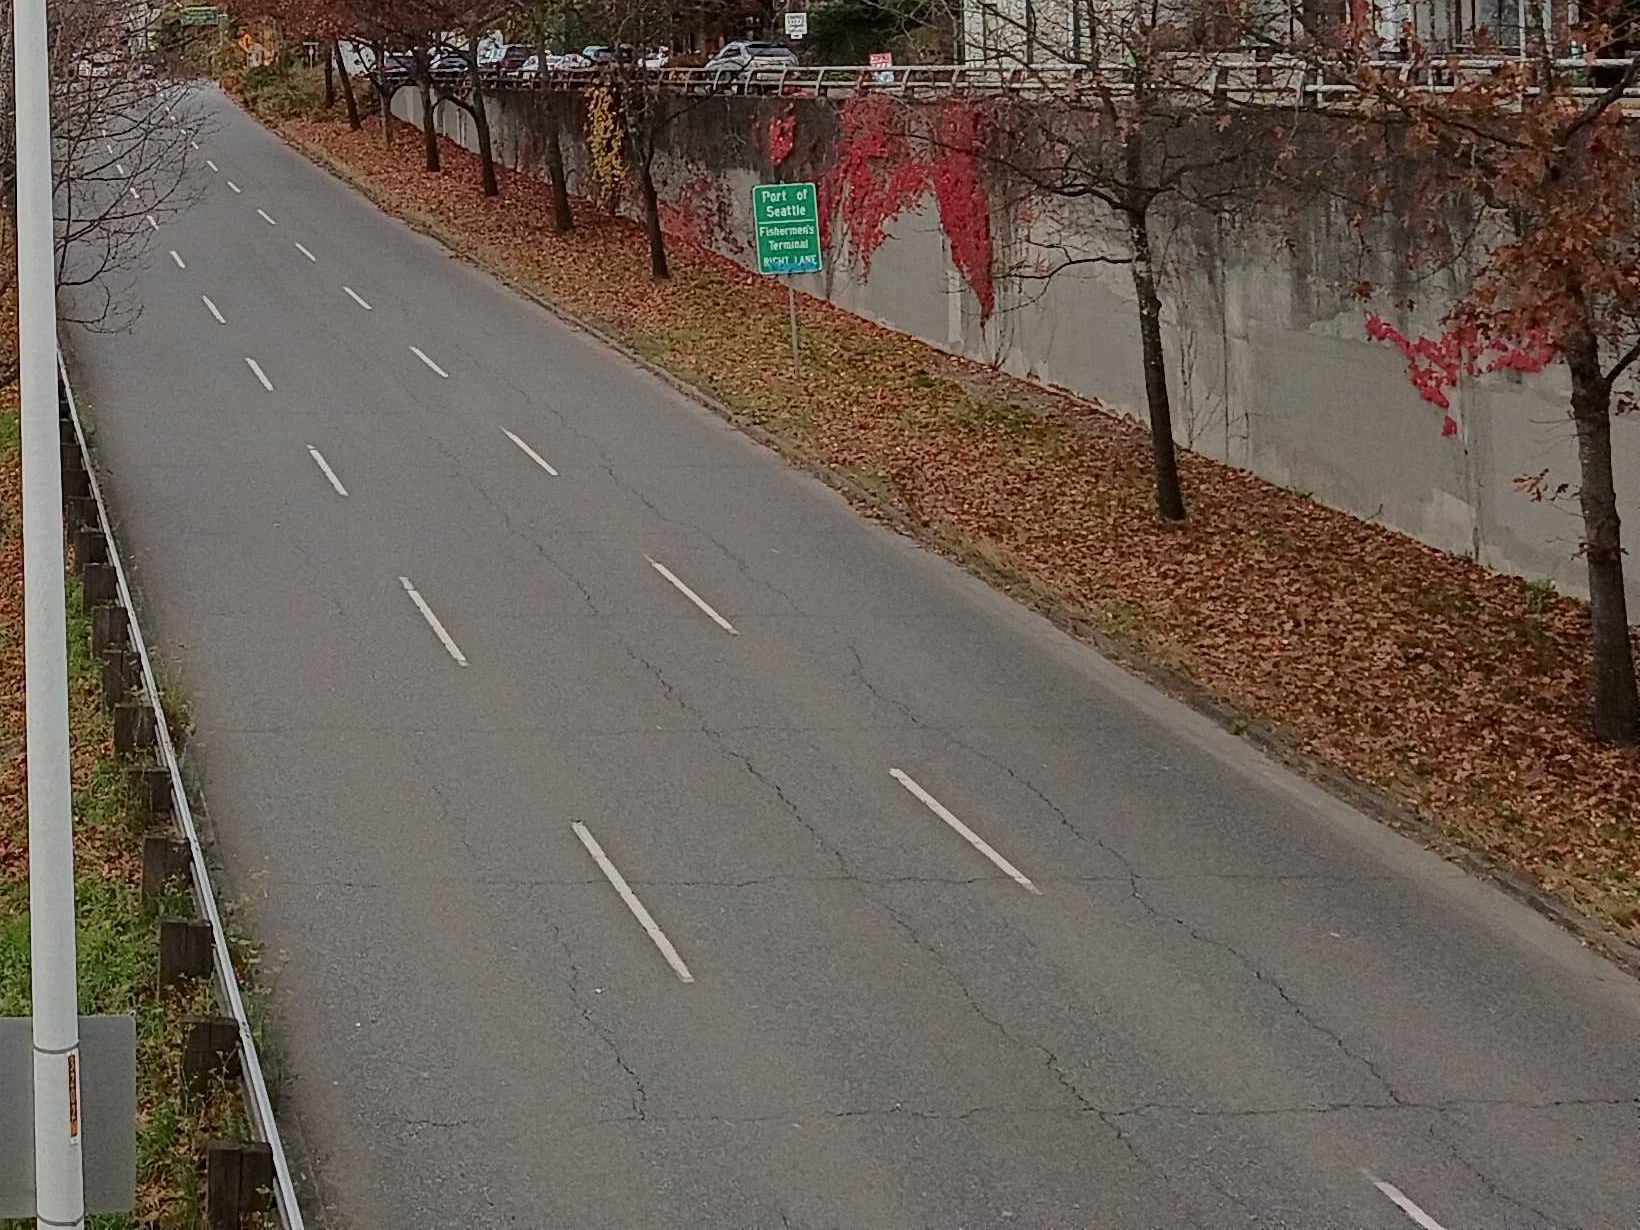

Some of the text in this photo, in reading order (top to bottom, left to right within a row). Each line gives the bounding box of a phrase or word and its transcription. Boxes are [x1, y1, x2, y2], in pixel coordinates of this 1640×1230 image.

[796, 189, 808, 201] of
[766, 204, 806, 217] Seattle
[759, 225, 815, 237] Fishermen's
[768, 239, 809, 251] Terminal
[763, 256, 789, 267] RIGHT
